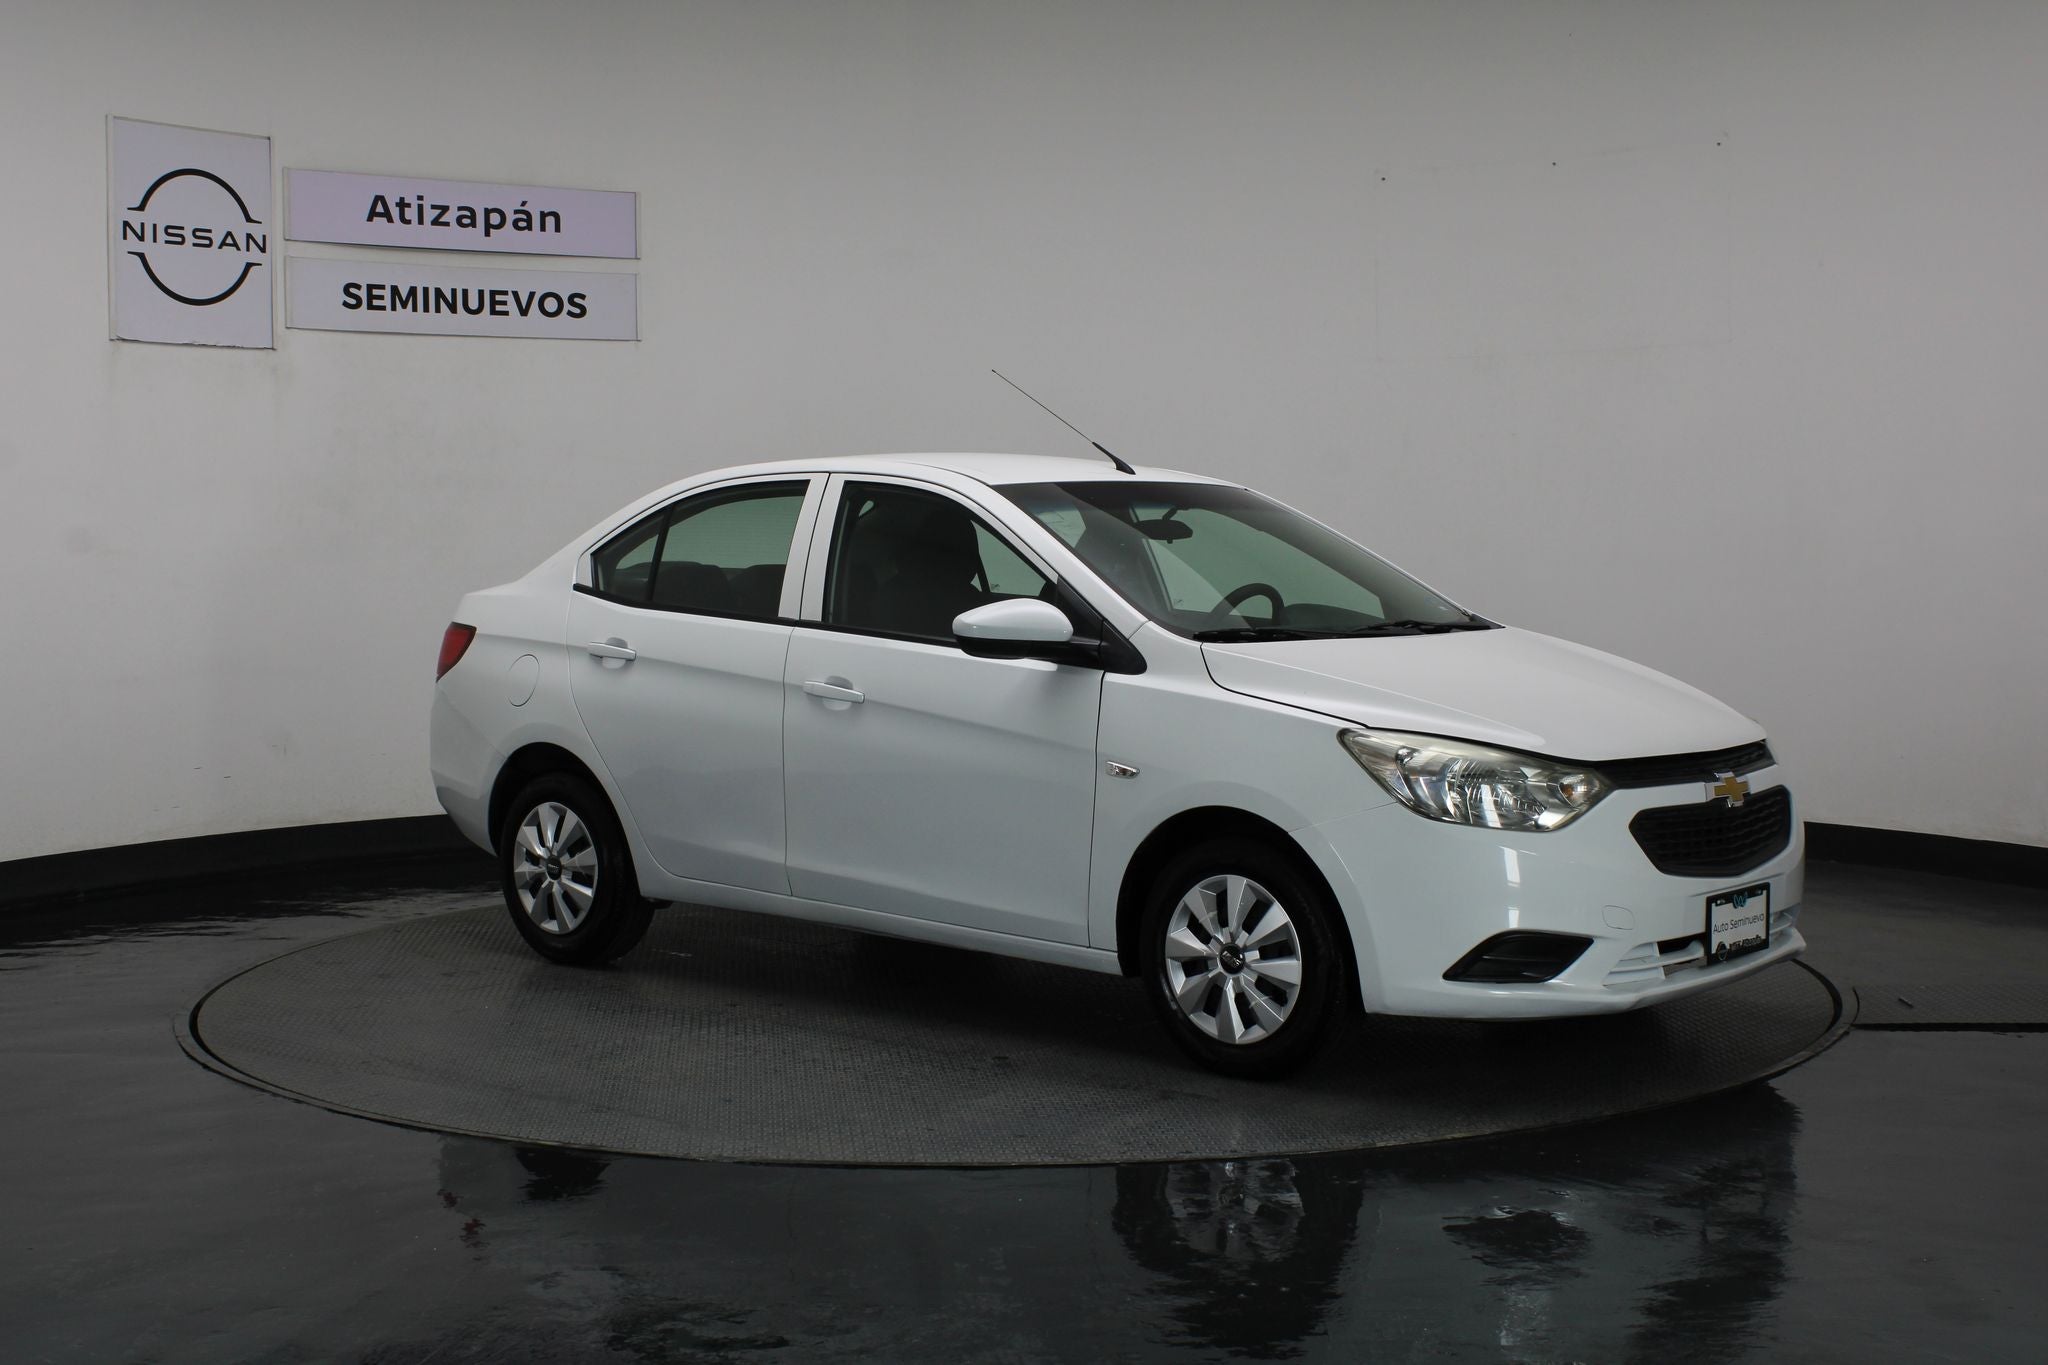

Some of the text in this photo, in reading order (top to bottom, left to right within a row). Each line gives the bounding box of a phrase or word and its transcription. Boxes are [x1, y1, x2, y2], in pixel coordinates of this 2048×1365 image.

[366, 194, 561, 237] Atizapán
[123, 220, 267, 254] NISSAN
[342, 283, 587, 319] SEMINUEVOS
[1713, 913, 1765, 935] Auto Seminuevo
